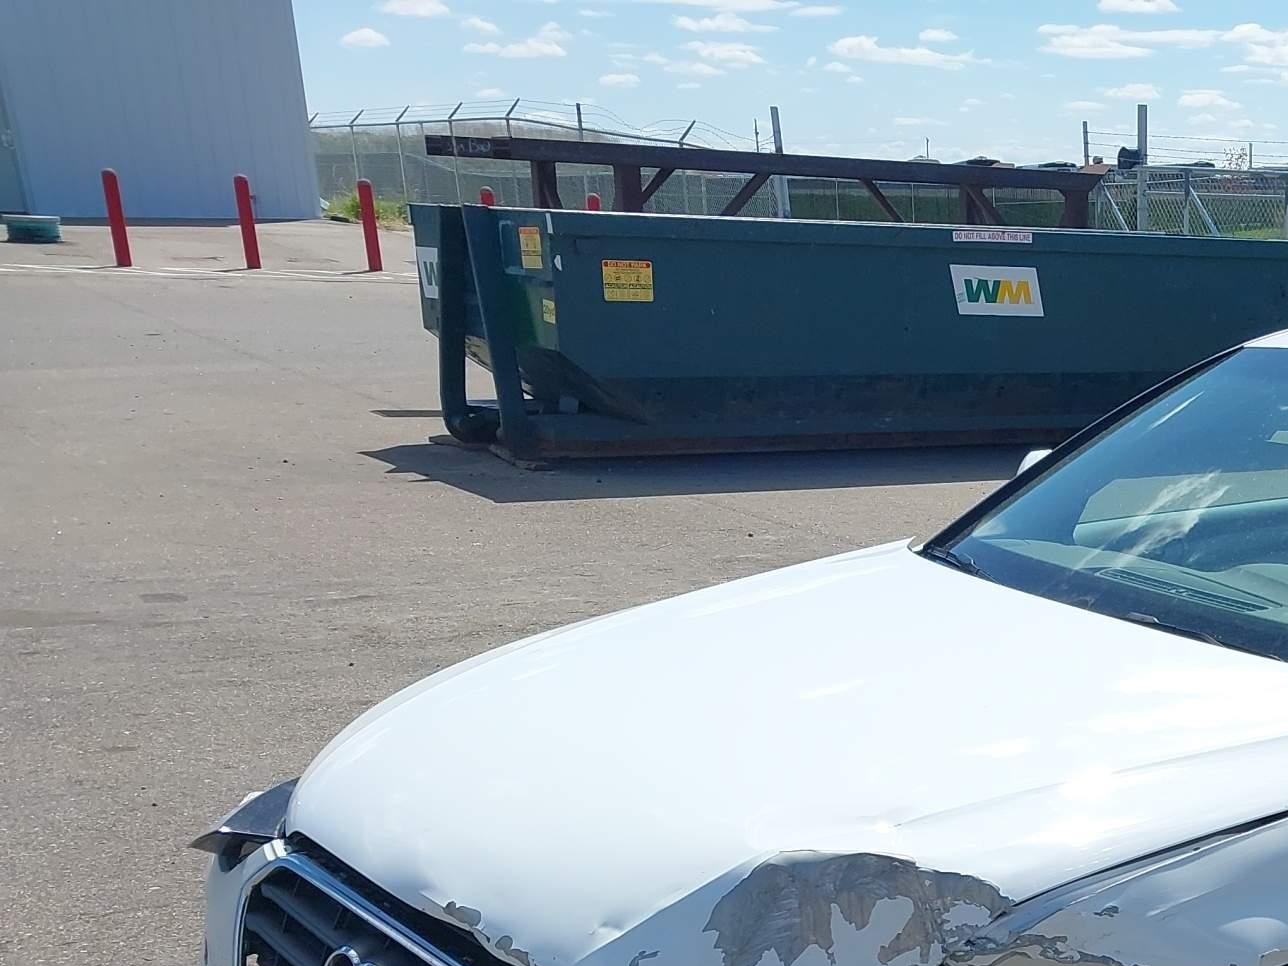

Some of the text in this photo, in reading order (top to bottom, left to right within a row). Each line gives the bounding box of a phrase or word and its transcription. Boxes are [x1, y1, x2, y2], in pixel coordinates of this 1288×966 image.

[954, 231, 963, 240] DO
[963, 231, 974, 240] NOT
[975, 232, 987, 240] FILL
[988, 232, 1006, 241] ABOVE
[1007, 233, 1018, 241] THIS
[963, 278, 1033, 304] WM
